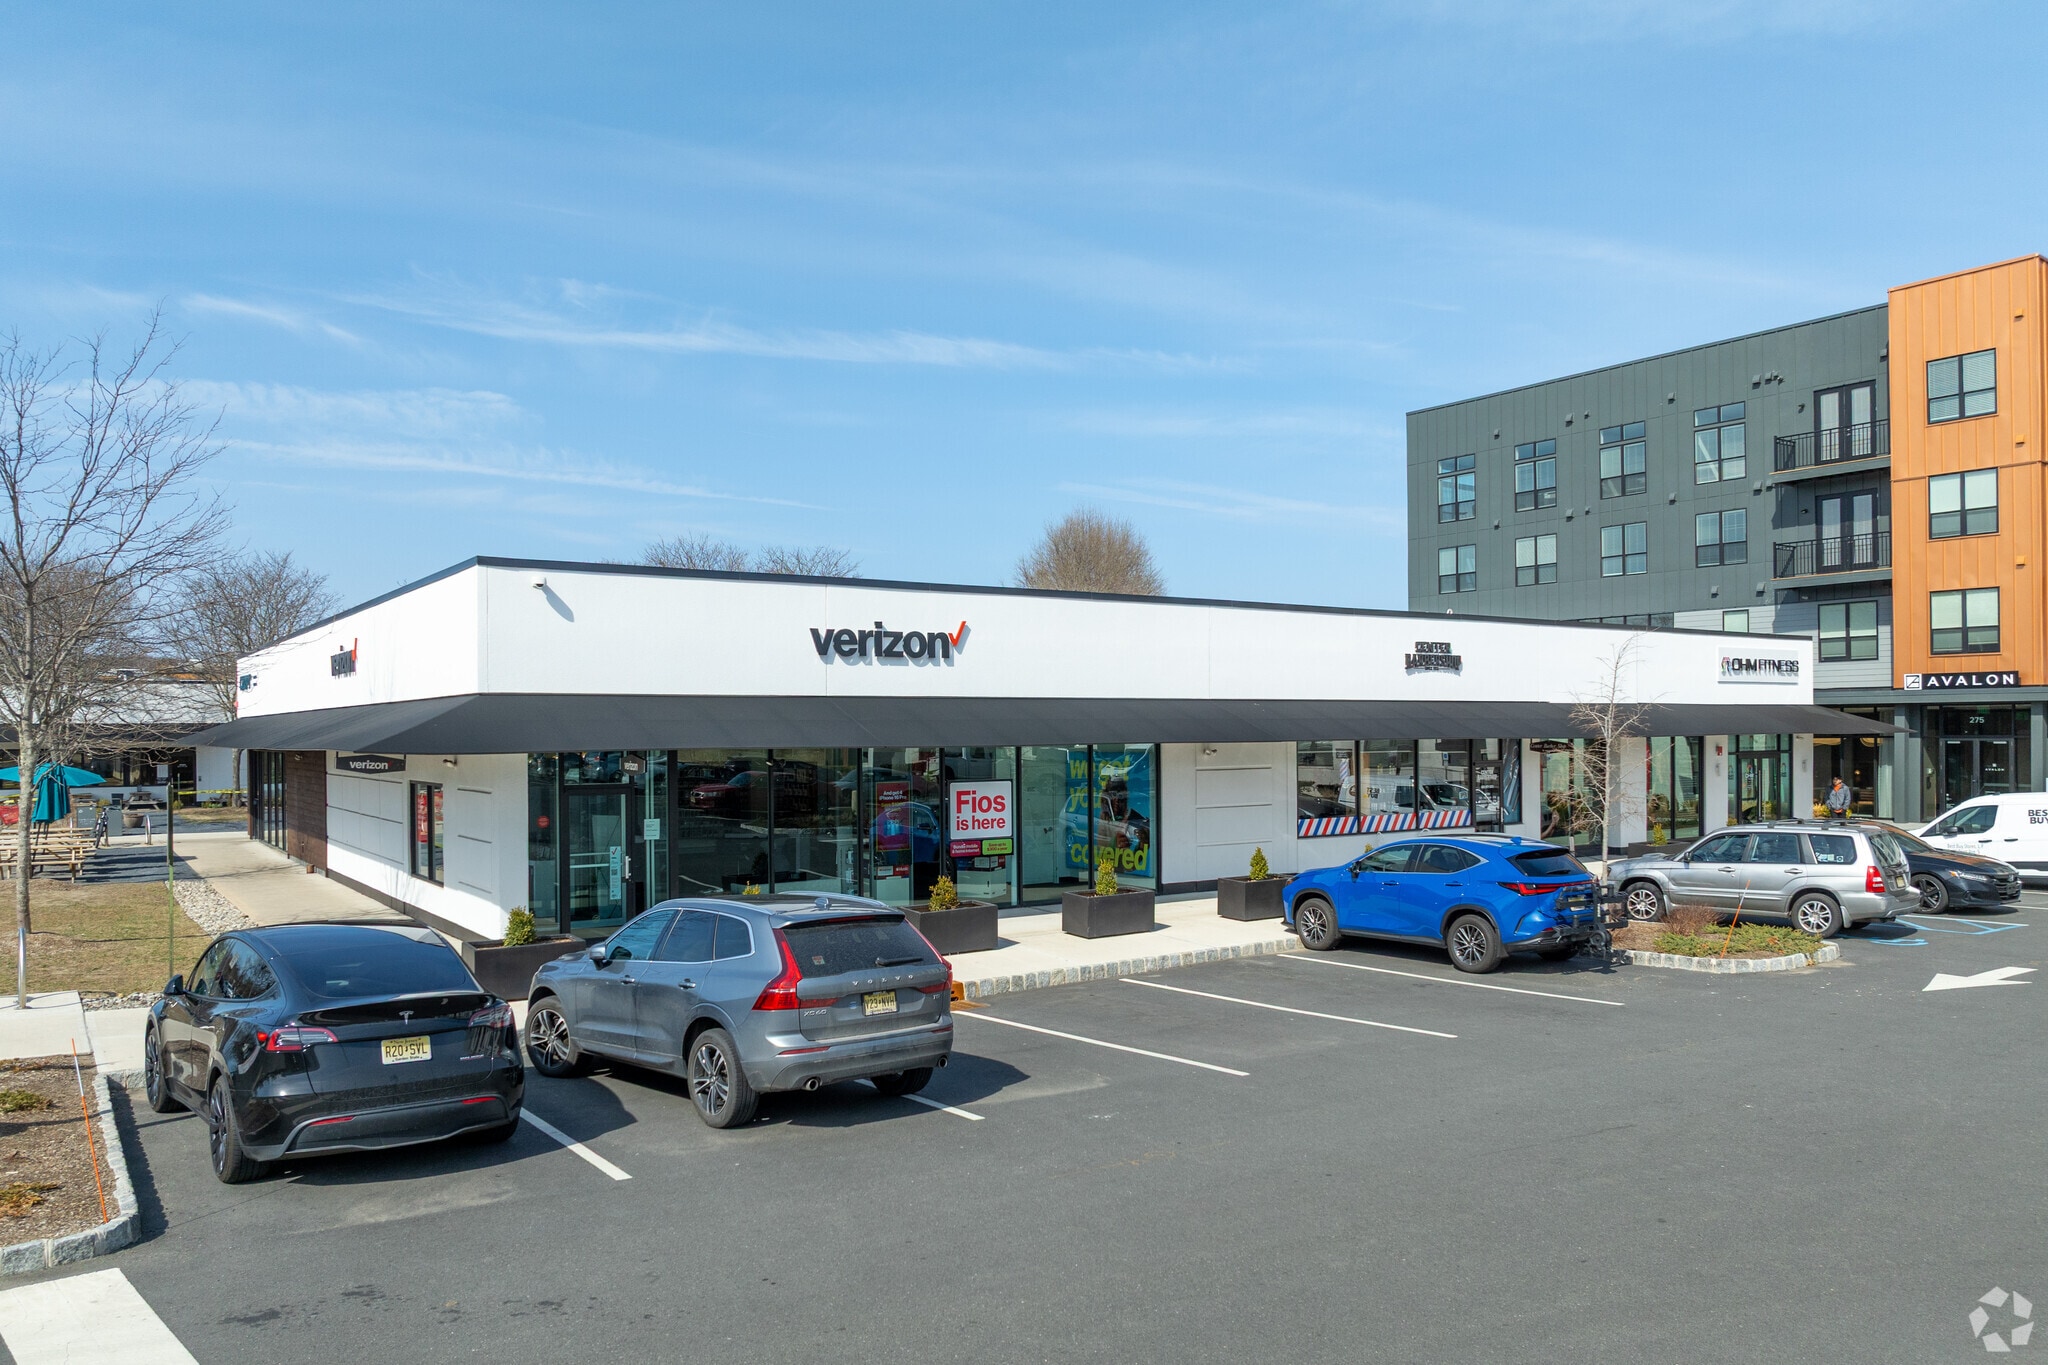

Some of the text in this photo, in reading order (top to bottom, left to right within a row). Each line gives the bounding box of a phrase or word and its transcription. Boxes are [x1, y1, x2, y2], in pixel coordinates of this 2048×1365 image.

[809, 621, 950, 659] verizon
[1732, 658, 1799, 673] OHM FITNESS
[1926, 674, 2015, 687] AVALON
[1969, 716, 1985, 724] 275
[349, 759, 389, 770] verizon
[956, 790, 1006, 814] Fios
[2028, 809, 2048, 817] BES
[956, 815, 1006, 831] is here
[852, 974, 914, 986] VOLVO
[803, 1009, 827, 1017] XC60
[410, 1042, 428, 1055] SVL
